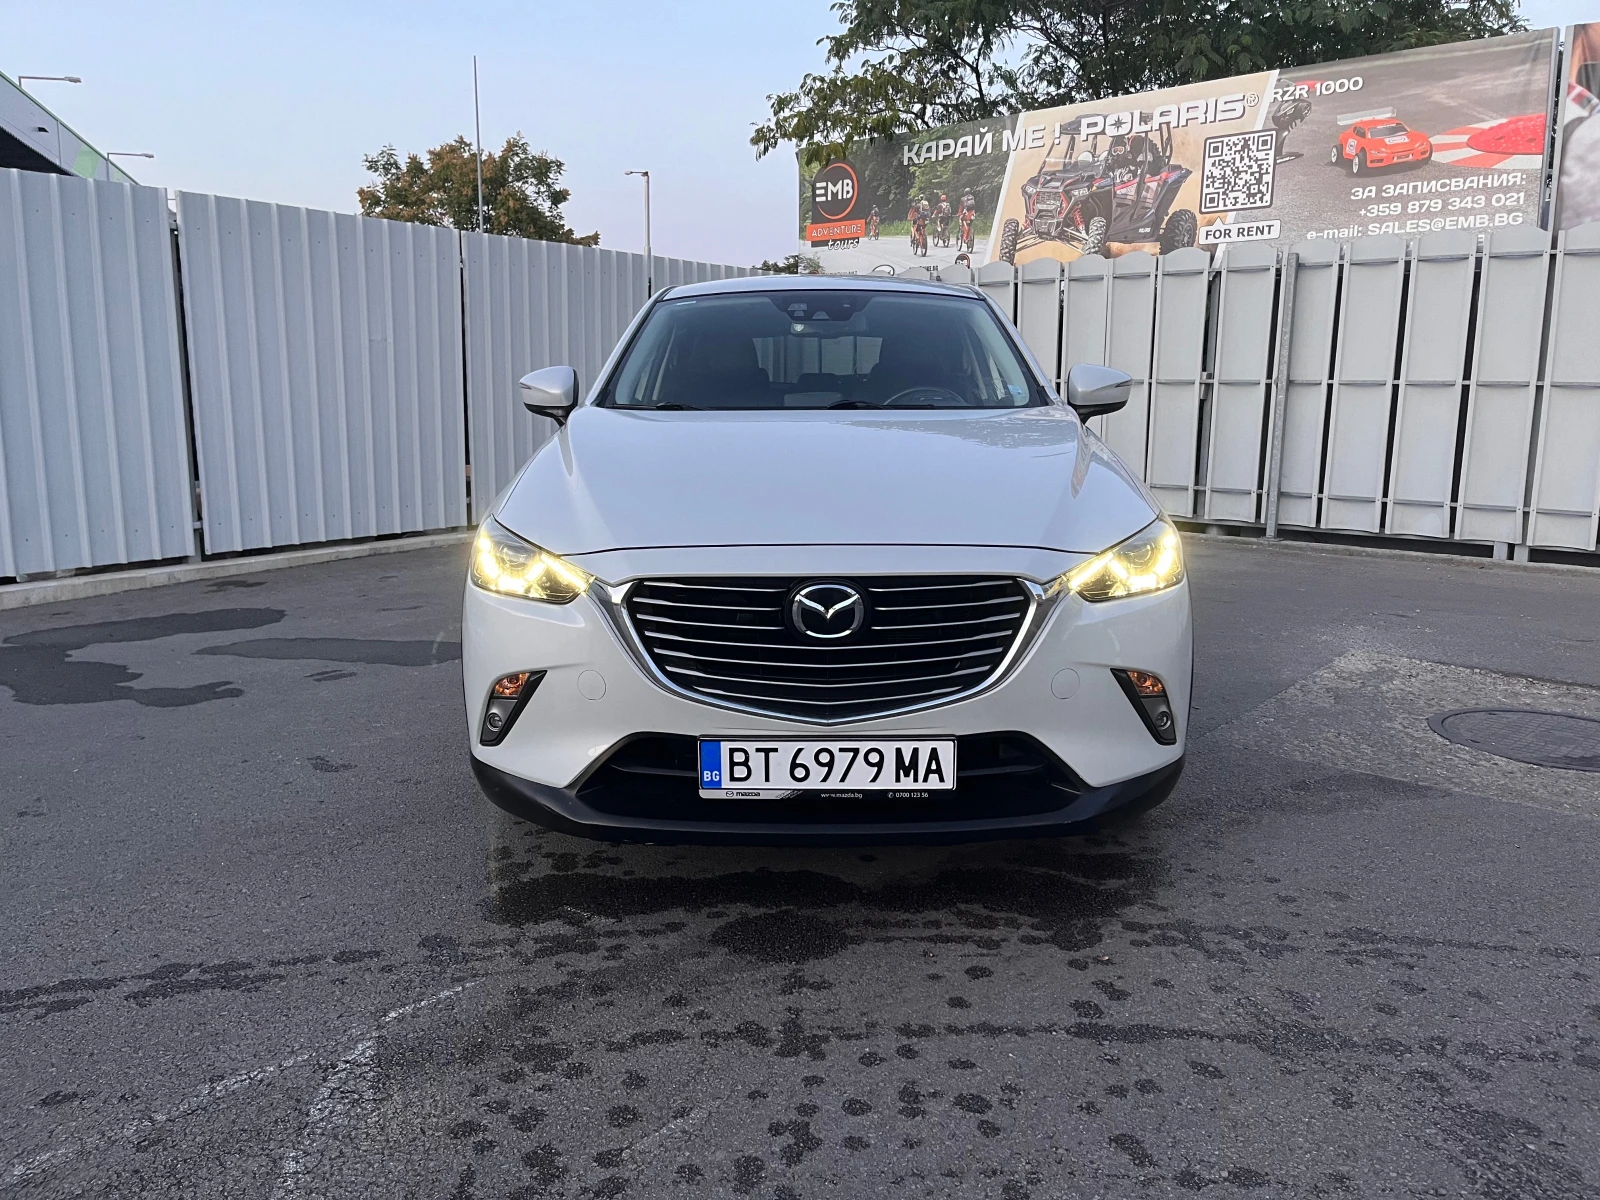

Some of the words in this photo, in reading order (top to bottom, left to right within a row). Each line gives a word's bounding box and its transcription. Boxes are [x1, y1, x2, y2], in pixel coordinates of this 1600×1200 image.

[1270, 84, 1309, 103] RZR
[1314, 76, 1364, 96] 1000
[903, 126, 994, 166] КАРАЙ
[1002, 125, 1046, 151] МЕ
[815, 178, 853, 202] EMB
[1350, 186, 1377, 200] ЗА
[1381, 172, 1527, 197] ЗАПИСВАНИЯ:
[1359, 202, 1402, 217] +359
[1407, 199, 1442, 214] 879
[1447, 195, 1486, 210] 343
[1491, 192, 1525, 207] 021
[811, 224, 862, 237] ADVENTURE
[1205, 228, 1232, 241] FOR
[1236, 224, 1275, 238] RENT
[1306, 224, 1362, 240] e-mail:
[1367, 212, 1523, 236] SALES@EMB.BG
[828, 238, 859, 250] tours
[703, 770, 720, 782] BG
[728, 747, 779, 783] BT
[788, 747, 885, 783] 6979
[894, 747, 946, 783] MA
